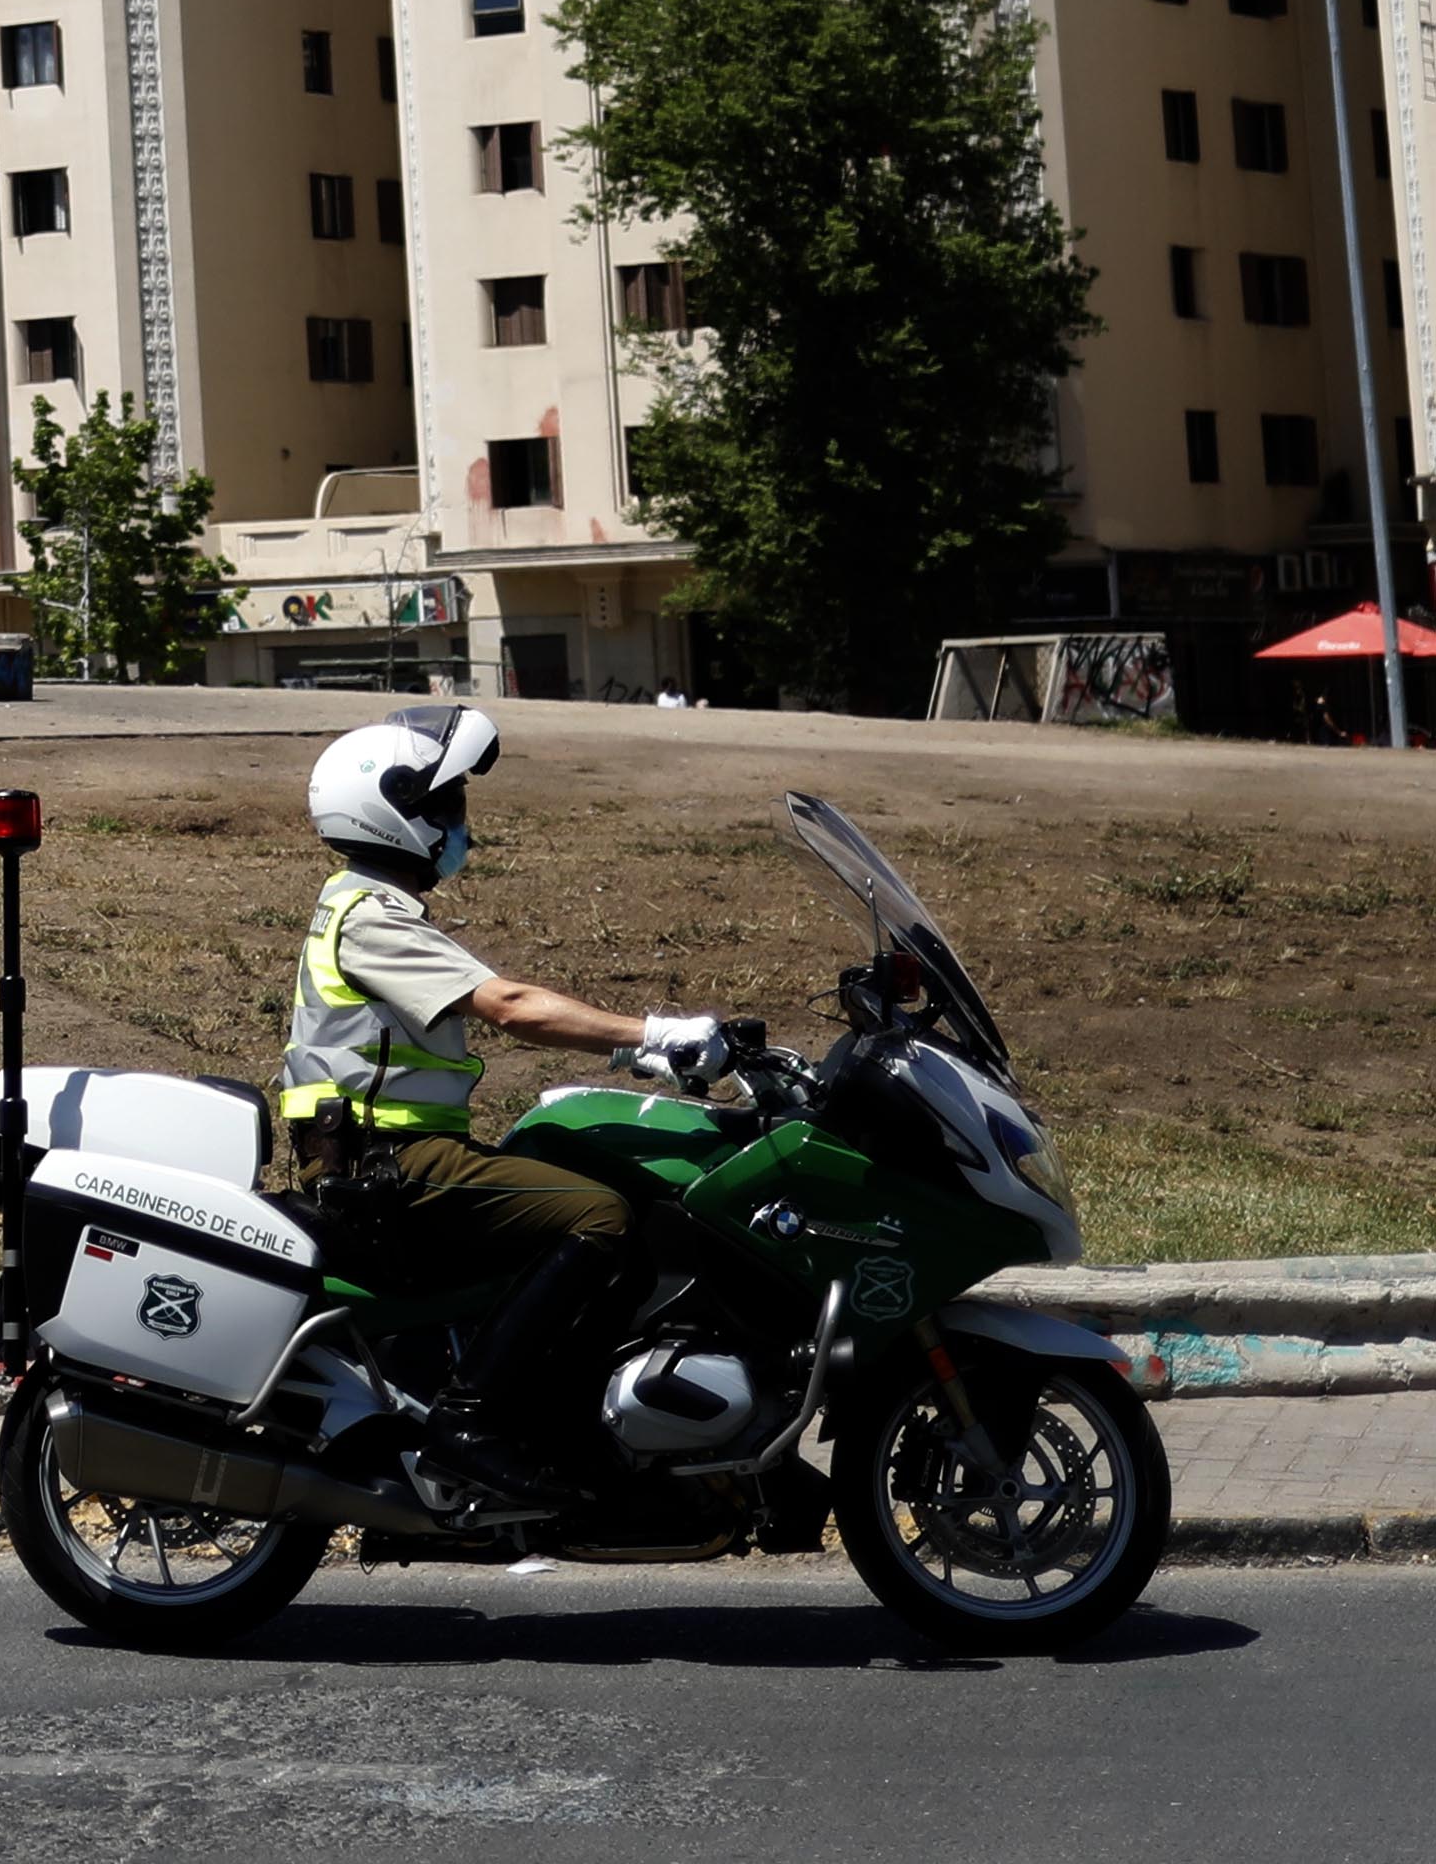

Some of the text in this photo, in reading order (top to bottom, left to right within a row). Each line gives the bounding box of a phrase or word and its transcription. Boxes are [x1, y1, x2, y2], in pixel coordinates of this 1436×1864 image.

[74, 1172, 295, 1257] CARABINEROS DE CHILE
[99, 1234, 128, 1251] BMW
